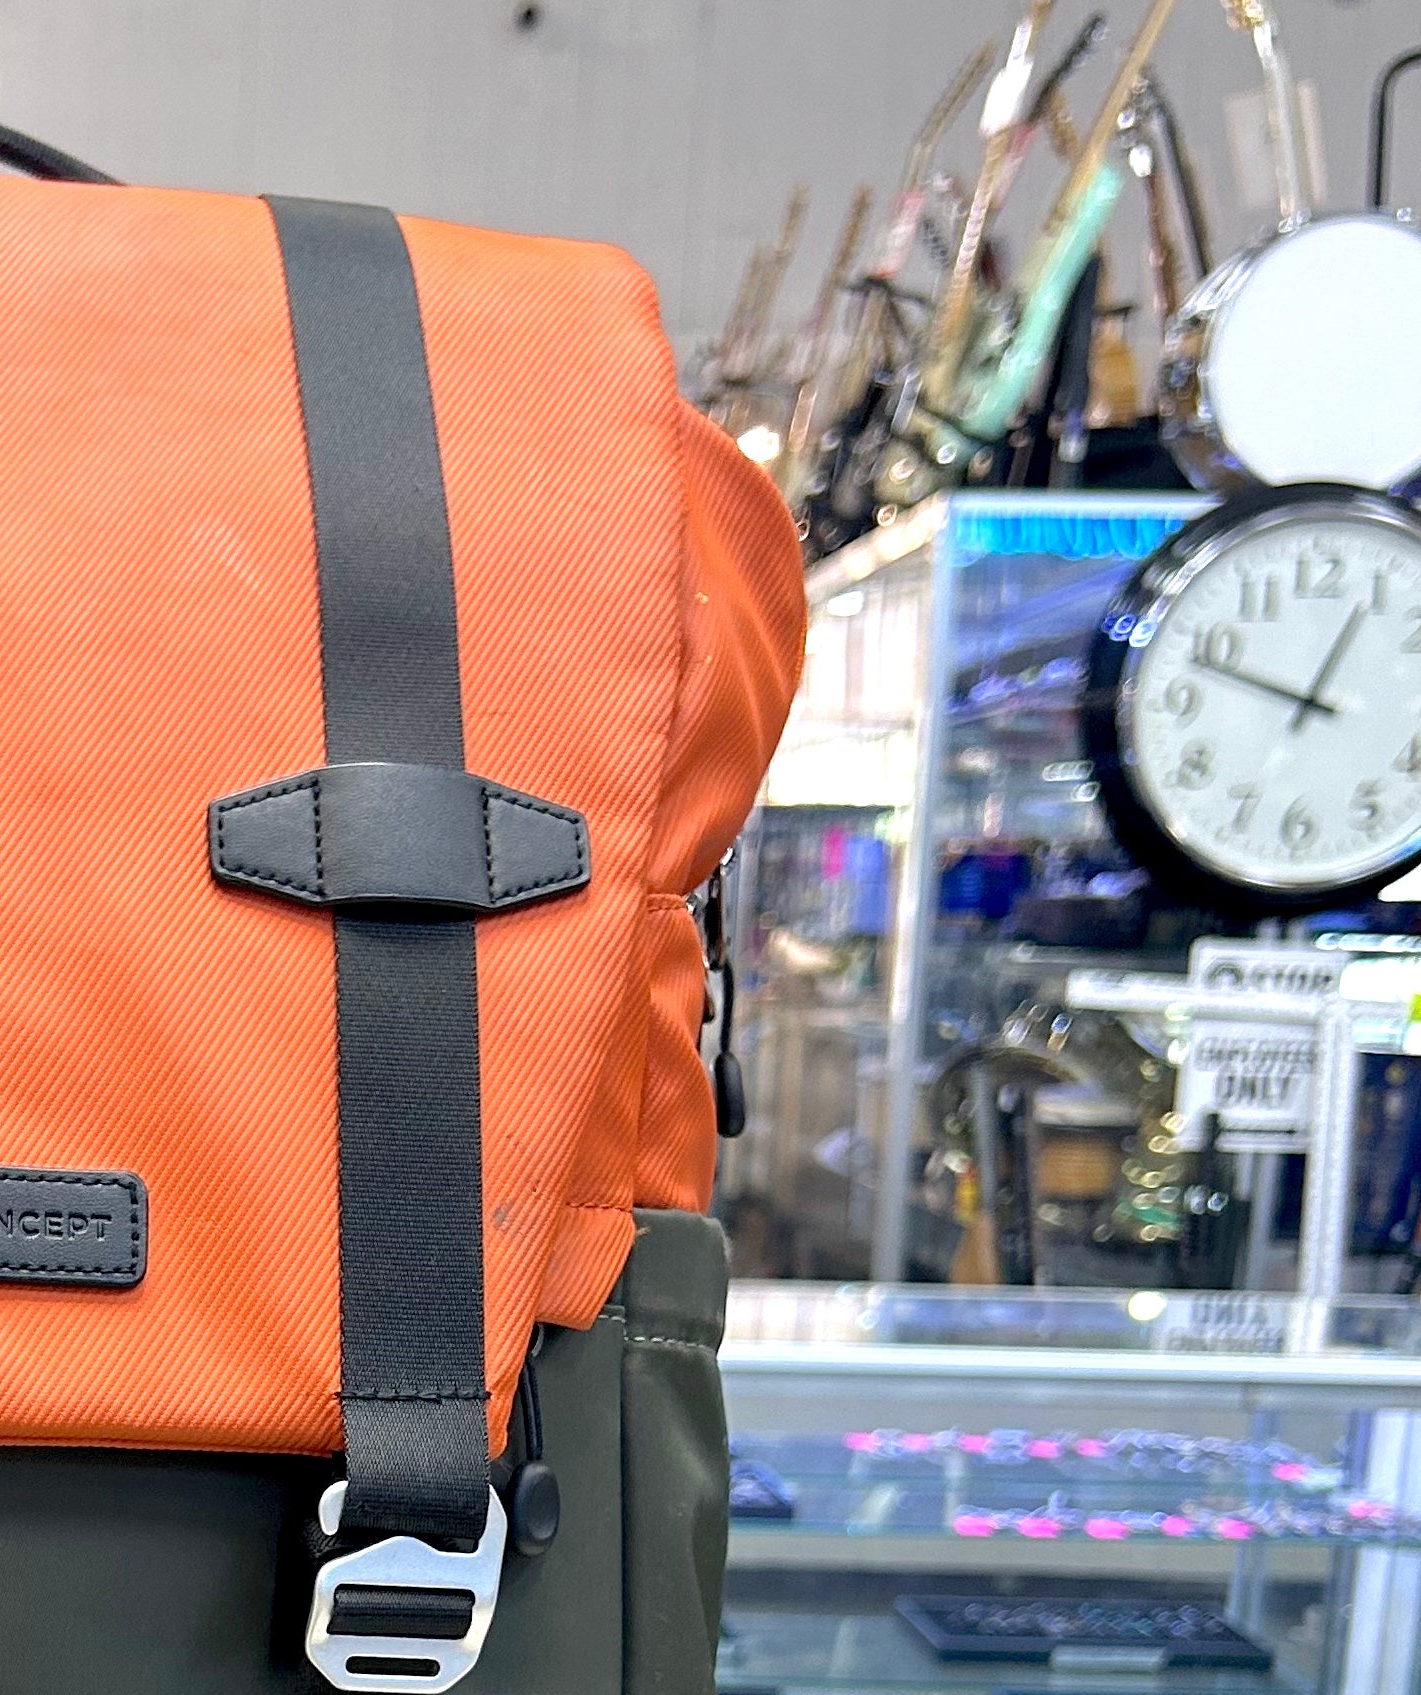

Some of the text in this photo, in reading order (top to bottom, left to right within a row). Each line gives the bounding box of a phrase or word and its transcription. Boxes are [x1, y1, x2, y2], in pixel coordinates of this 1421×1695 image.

[1238, 574, 1279, 621] 11
[1295, 553, 1346, 598] 12
[1372, 570, 1389, 614] 1
[1191, 621, 1242, 671] 10
[1164, 675, 1204, 728] 9
[1177, 739, 1217, 790] 8
[1227, 782, 1263, 833] 7
[1280, 793, 1319, 851] 6
[1351, 778, 1386, 831] 5
[1216, 1070, 1293, 1109] ONLY
